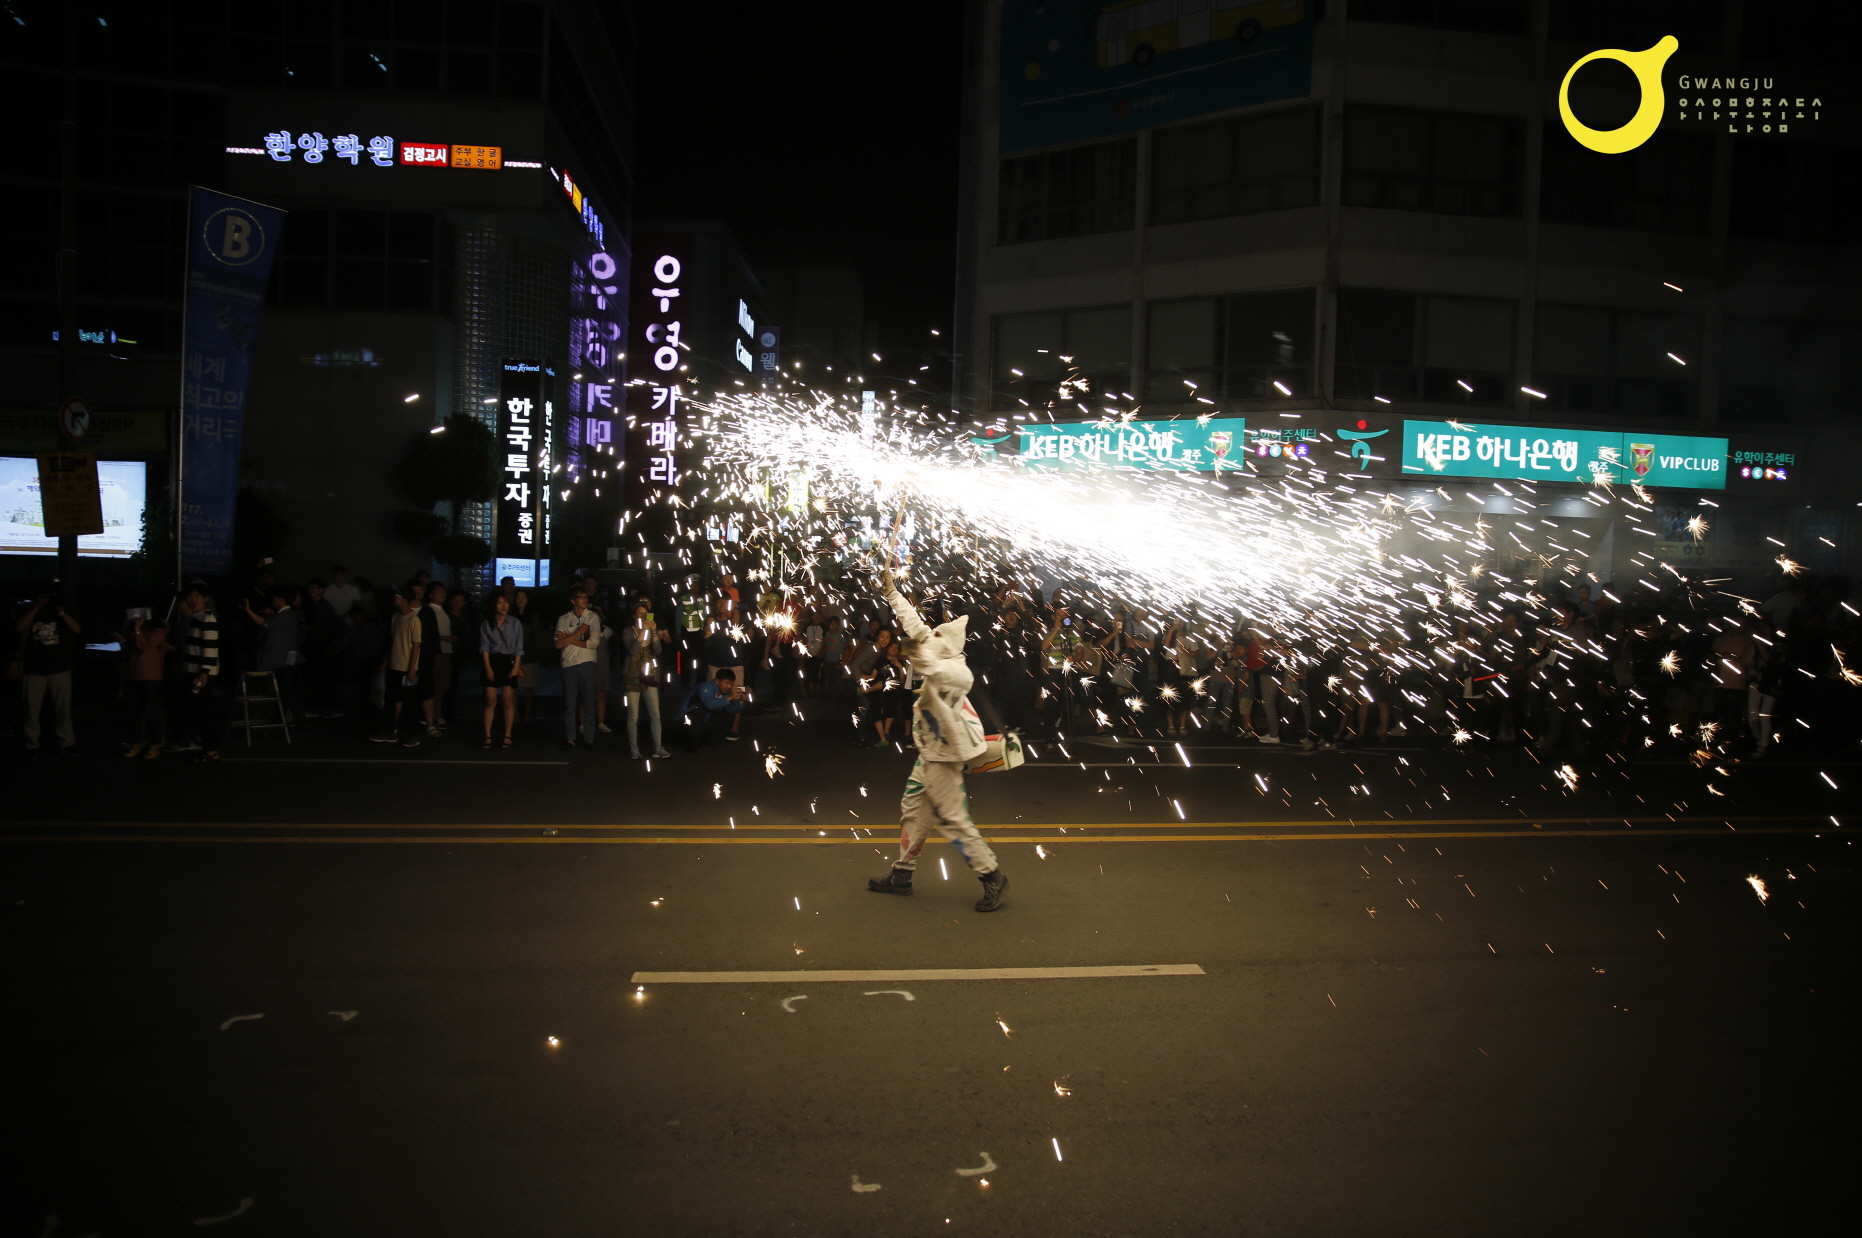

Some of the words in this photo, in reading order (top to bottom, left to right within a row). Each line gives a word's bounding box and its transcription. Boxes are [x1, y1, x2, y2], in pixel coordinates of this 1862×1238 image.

[263, 130, 395, 167] 한양학원
[403, 146, 447, 164] 검정고시
[221, 214, 252, 259] B
[186, 353, 227, 384] 세계
[760, 352, 776, 371] 웰
[185, 382, 245, 412] 최고의
[1079, 431, 1174, 462] 하나은행
[1416, 433, 1471, 461] KEB
[1476, 435, 1579, 472] 하나은행
[1733, 450, 1796, 466] 유학이주센터
